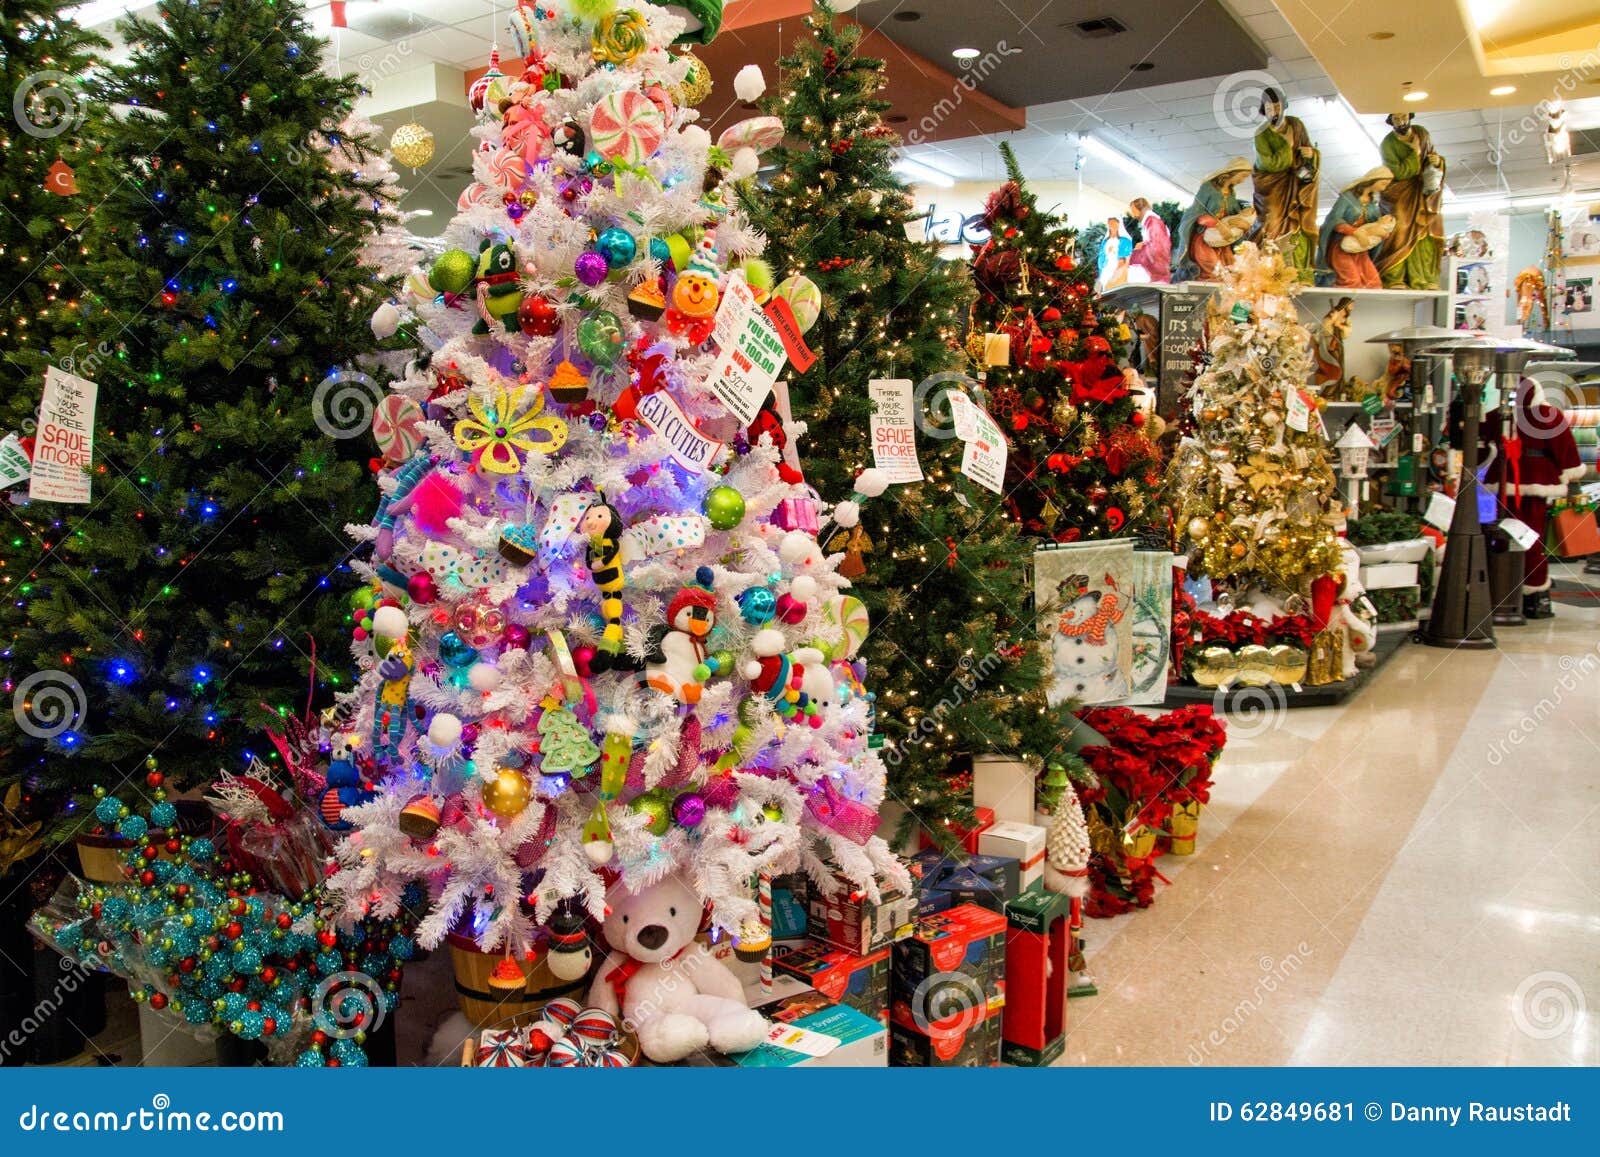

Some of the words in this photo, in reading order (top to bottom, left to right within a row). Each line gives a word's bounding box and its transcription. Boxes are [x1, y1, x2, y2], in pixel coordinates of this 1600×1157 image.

[1169, 319, 1188, 332] IT'S
[746, 317, 763, 342] YOU
[763, 333, 785, 358] SAVE
[731, 349, 753, 375] NOW
[745, 342, 775, 375] 100.00
[57, 397, 84, 414] YOUR
[59, 407, 77, 417] OLD
[881, 402, 905, 411] YOUR
[49, 411, 86, 431] TREE
[642, 395, 672, 429] GLY
[664, 417, 711, 463] CUTIES
[876, 416, 909, 425] TREE
[41, 445, 91, 467] MORE
[877, 445, 916, 457] MORE
